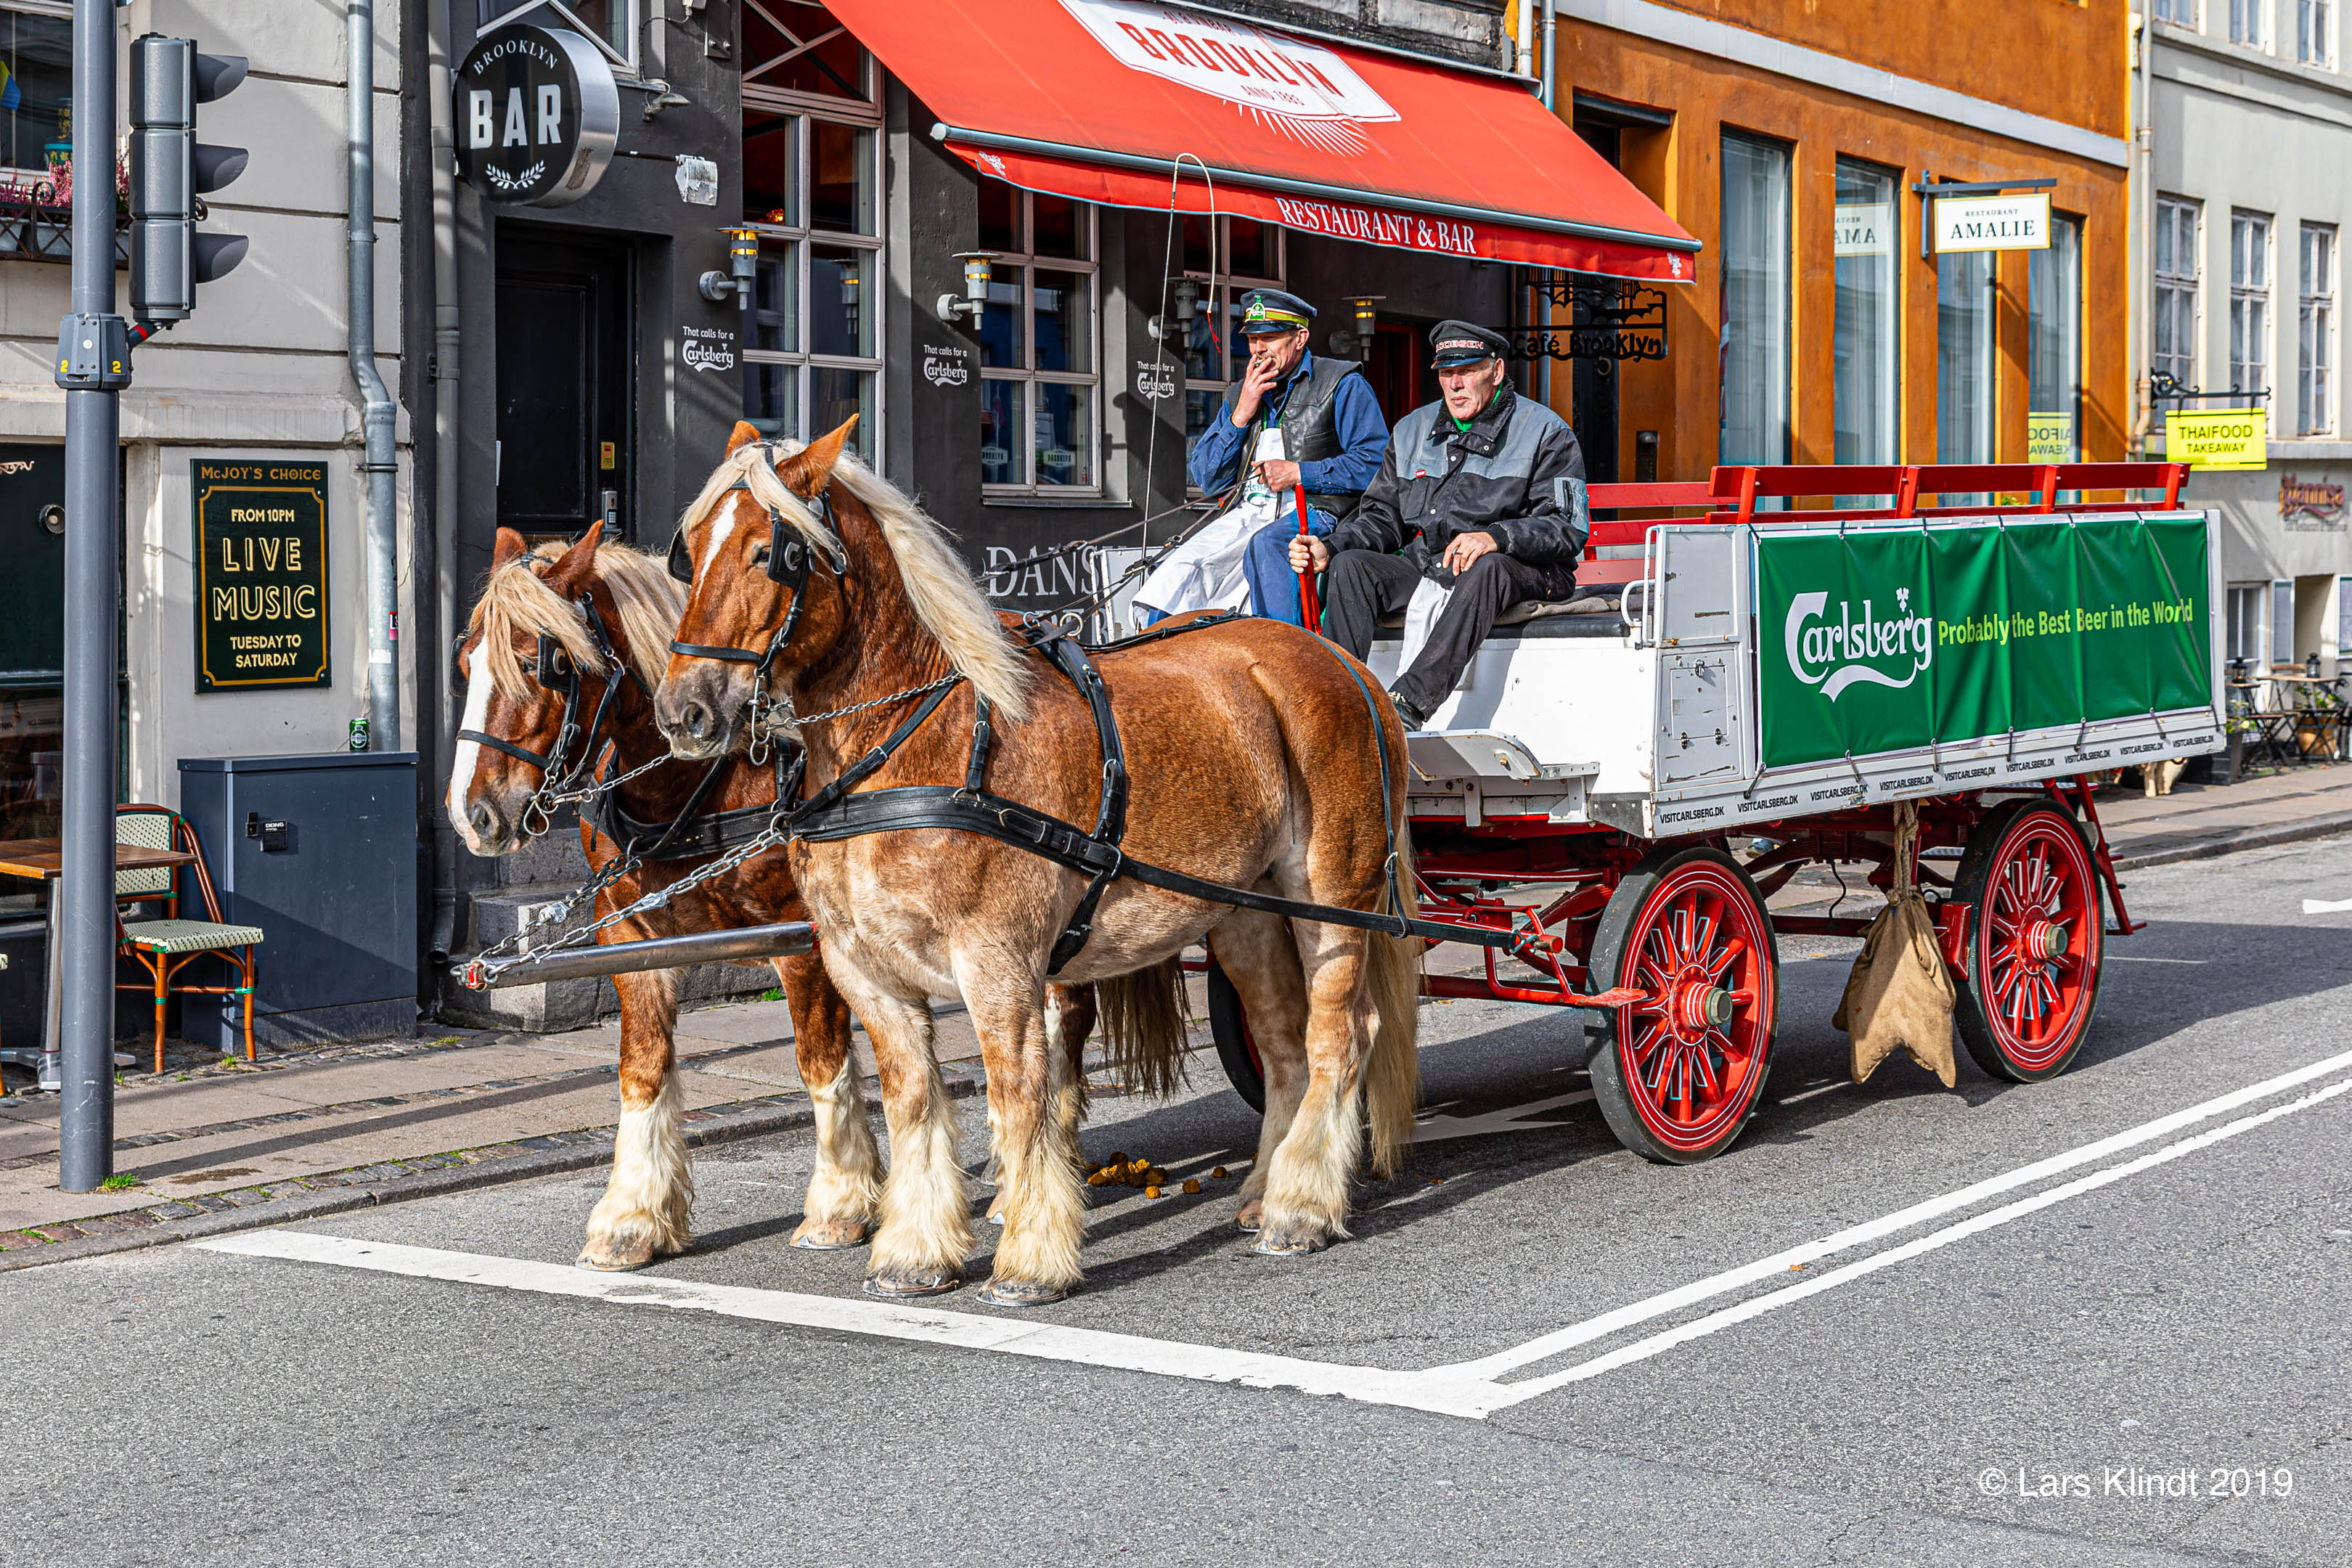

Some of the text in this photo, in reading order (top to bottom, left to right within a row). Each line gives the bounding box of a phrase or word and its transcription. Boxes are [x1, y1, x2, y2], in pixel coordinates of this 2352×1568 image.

[473, 39, 558, 75] BROOKLYN
[1115, 21, 1345, 98] BROOKLYN
[1241, 84, 1275, 100] ANNO
[470, 84, 561, 149] BAR
[1965, 208, 2018, 217] RESTAURANT
[1274, 197, 1477, 254] RESTAURANT & BAR
[1951, 219, 2035, 240] AMALIE
[682, 326, 699, 337] That
[701, 328, 716, 338] calls
[717, 329, 728, 340] for
[923, 344, 938, 354] That
[939, 346, 952, 356] calls
[953, 347, 963, 356] for
[1514, 332, 1561, 354] Café
[682, 340, 734, 372] Carlsberg
[60, 359, 68, 372] 2
[113, 360, 121, 373] 2
[923, 356, 967, 387] Carlsberg
[1137, 360, 1149, 369] That
[2179, 425, 2253, 440] THAIFOOD
[2186, 442, 2246, 454] TAKEAWAY
[270, 468, 321, 481] CHOICE
[232, 509, 295, 522] FROM 10PM
[223, 538, 301, 571] LIVE
[986, 545, 1111, 597] DANS
[213, 584, 315, 621] MUSIC
[1939, 597, 2193, 645] Probably the Best Beer in the World
[230, 634, 301, 650] TUESDAY TO
[1784, 587, 1932, 703] Carlsberg
[236, 653, 297, 668] SATURDAY
[2119, 741, 2164, 756] VISITCARLSBERG.DK
[2172, 735, 2214, 748] VISITCARLSBERG.DK
[2065, 748, 2111, 764] VISITCARLSBERG.DK
[2006, 757, 2055, 773] VISITCARLSBERG.DK
[1944, 767, 1996, 783] VISITCARLSBERG.DK
[1879, 775, 1934, 792] VISITCARLSBERG.DK
[1810, 783, 1869, 801] VISITCARLSBERG.DK
[1737, 794, 1798, 813] VISITCARLSBERG.DK
[1659, 806, 1724, 824] VISITCARLSBERG.DK
